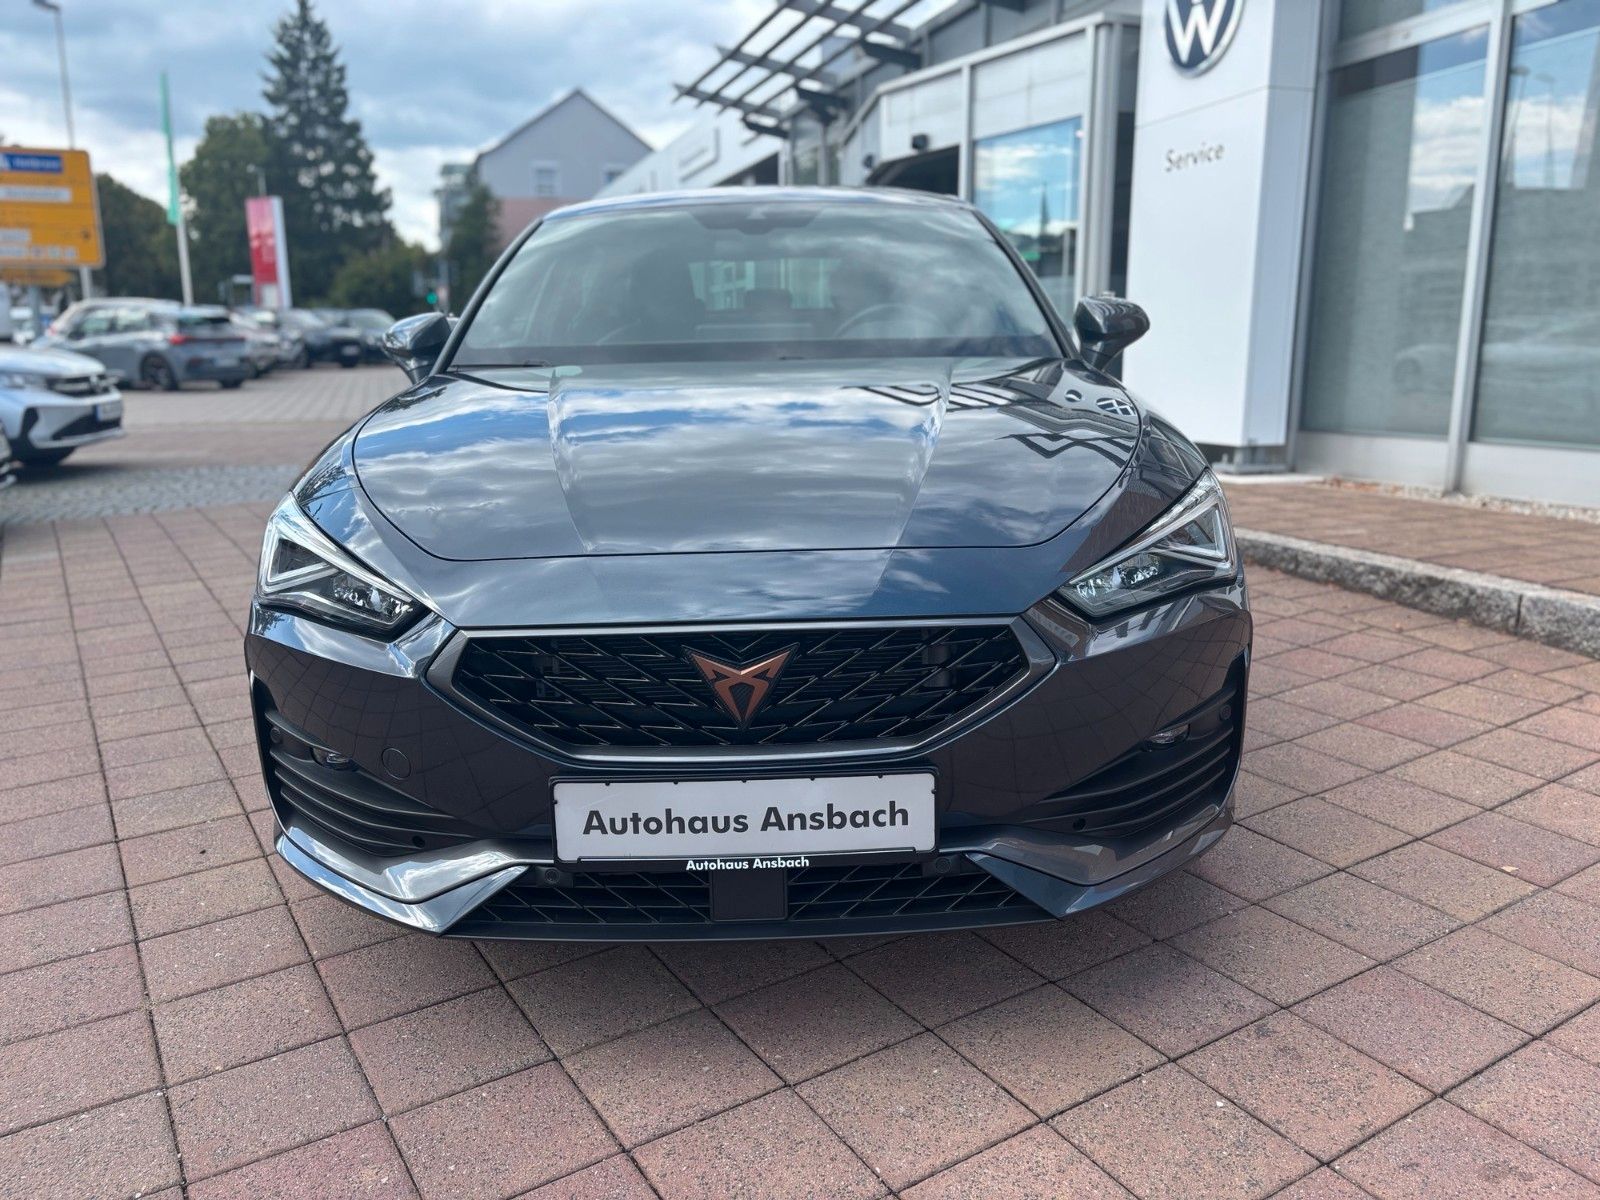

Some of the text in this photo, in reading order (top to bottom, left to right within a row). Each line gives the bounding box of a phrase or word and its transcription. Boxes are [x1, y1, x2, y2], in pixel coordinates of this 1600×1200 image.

[1165, 142, 1225, 172] Service
[582, 800, 909, 836] Autohaus Ansbach
[685, 856, 810, 871] Autohaus Ansbach
